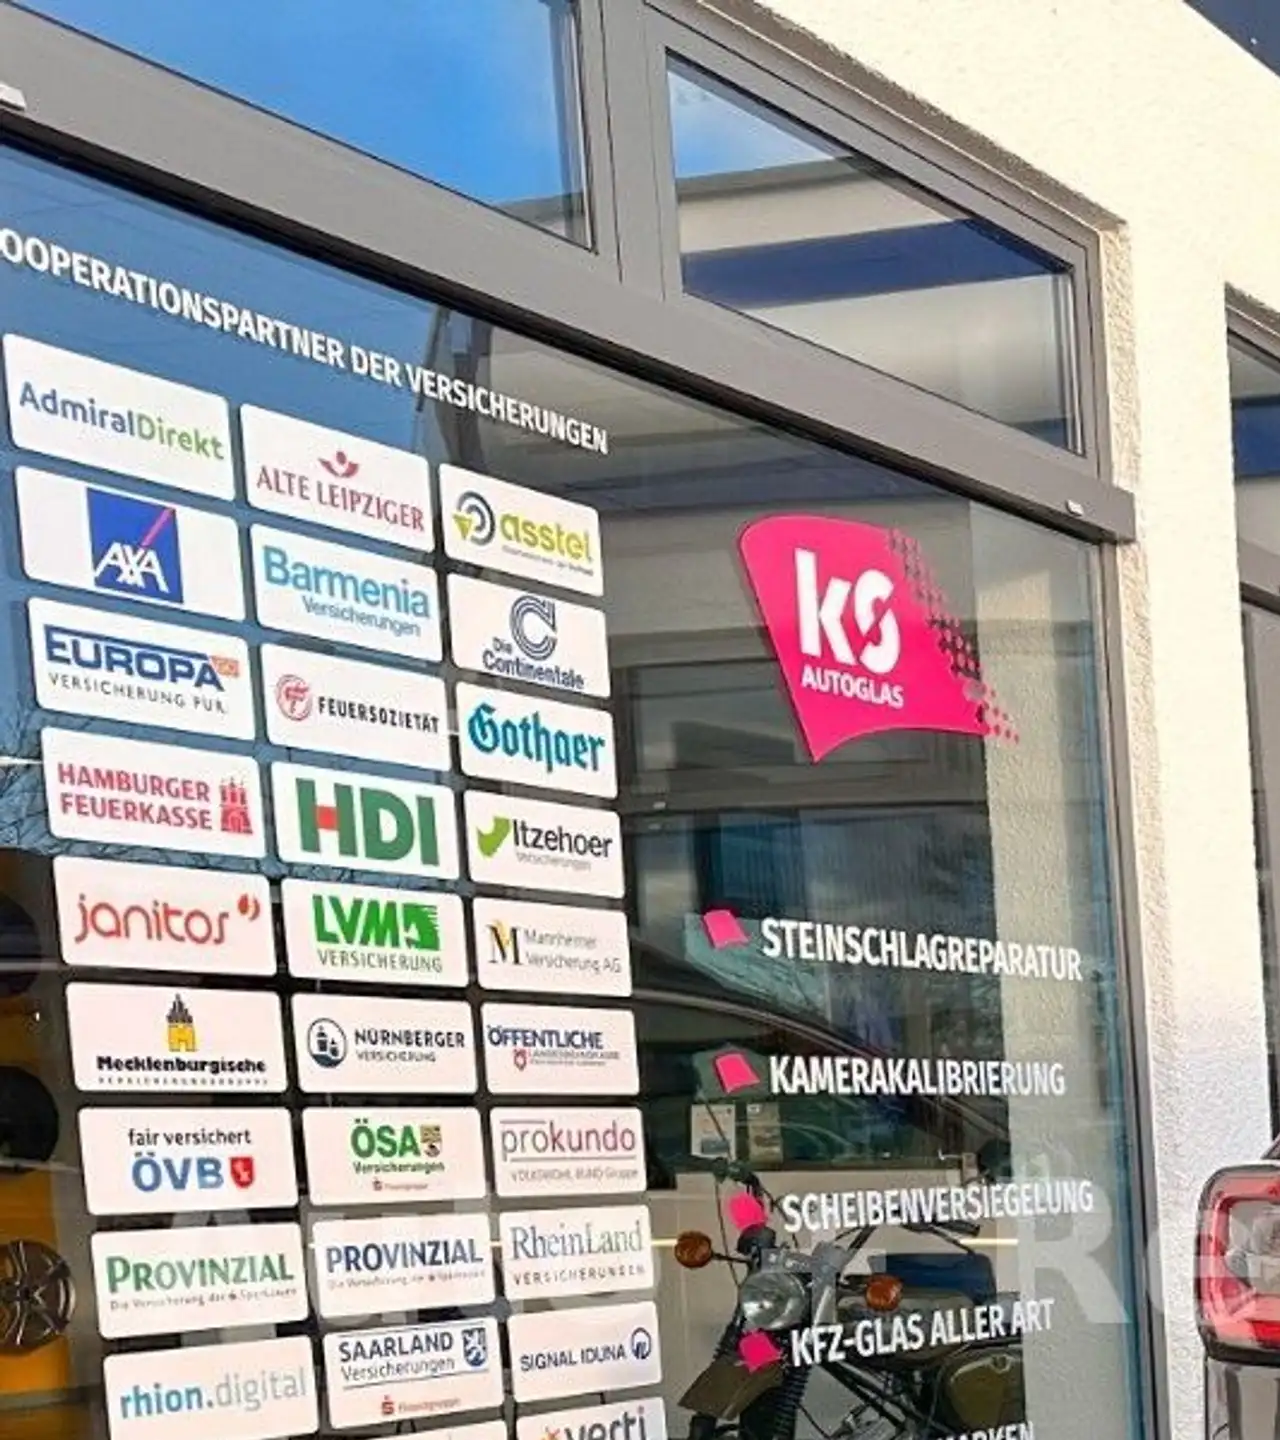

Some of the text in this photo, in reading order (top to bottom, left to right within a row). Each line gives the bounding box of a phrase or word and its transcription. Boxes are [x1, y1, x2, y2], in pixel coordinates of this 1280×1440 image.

[0, 227, 610, 455] OOPERATIONSPARTNER DER VERSICHERUNGEN
[19, 380, 226, 461] AdmiralDirekt
[256, 465, 426, 532] ALTE LEIPZIGER
[499, 513, 593, 563] asstel
[94, 542, 169, 596] AXA
[263, 544, 431, 619] Barmenia
[301, 595, 422, 637] Versicherungen
[43, 624, 226, 692] EUROPA
[482, 650, 586, 690] Continentale
[48, 671, 187, 709] VERSICHERUNG
[801, 664, 905, 709] AUTOGLAS
[317, 695, 440, 735] FEUERSOZIETÄT
[467, 701, 606, 773] Gothaer
[57, 762, 211, 803] HAMBURGER
[60, 792, 213, 832] FEUERKASSE
[295, 777, 440, 867] HDI
[512, 818, 614, 859] Itzehoer
[74, 893, 230, 945] janitos
[311, 894, 403, 949] LVM
[316, 949, 444, 974] VERSICHERUNG
[760, 916, 1084, 982] STEINSCHLAGREPARATUR
[354, 1025, 466, 1049] NÜRNBERGER
[486, 1023, 604, 1051] ÖFFENTLICHE
[95, 1054, 267, 1077] Mecklenburgische
[768, 1054, 1067, 1097] KAMERAKALIBRIERUNG
[128, 1127, 252, 1148] fair versichert
[351, 1117, 422, 1160] ÖSA
[501, 1119, 637, 1162] prokundo
[131, 1151, 225, 1193] ÖVB
[782, 1177, 1095, 1233] SCHEIBENVERSIEGELUNG
[325, 1238, 485, 1274] PROVINZIAL
[508, 1218, 644, 1261] RheinLand
[105, 1253, 295, 1294] PROVINZIAL
[338, 1330, 455, 1363] SAARLAND
[790, 1298, 1055, 1368] KFZ-GLAS ALLER ART
[341, 1355, 456, 1384] Versicherungen
[520, 1343, 627, 1373] SIGNAL IDUNA
[119, 1366, 307, 1419] rhion.digital
